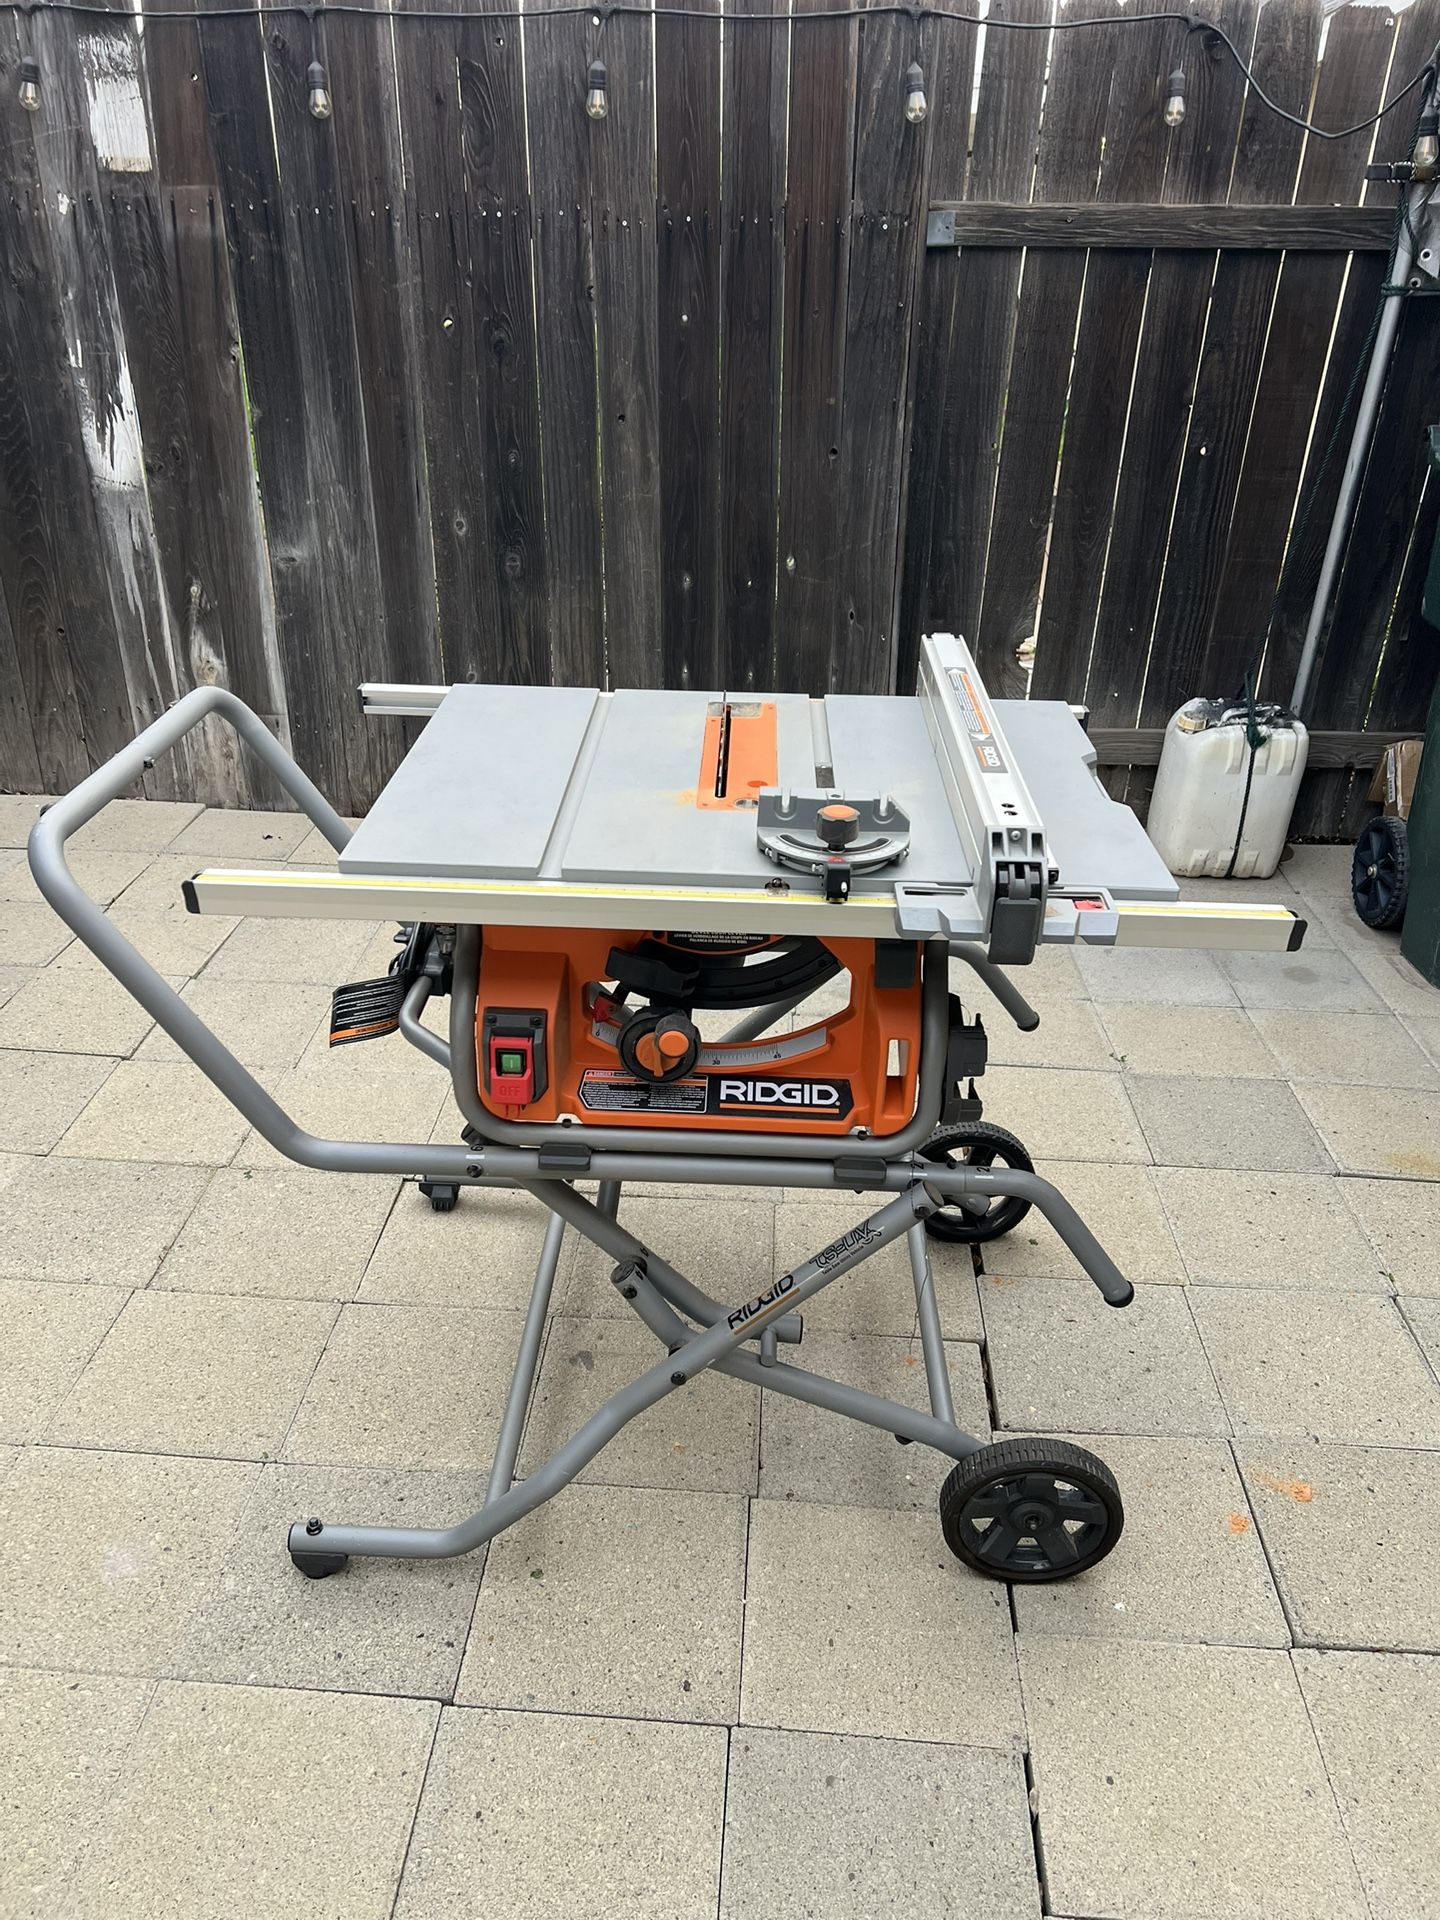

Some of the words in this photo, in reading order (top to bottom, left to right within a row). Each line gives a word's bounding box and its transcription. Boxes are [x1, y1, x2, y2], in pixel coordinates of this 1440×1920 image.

[499, 1086, 521, 1096] OFF
[719, 1080, 840, 1106] RIDGID
[728, 1274, 794, 1330] RIDGID
